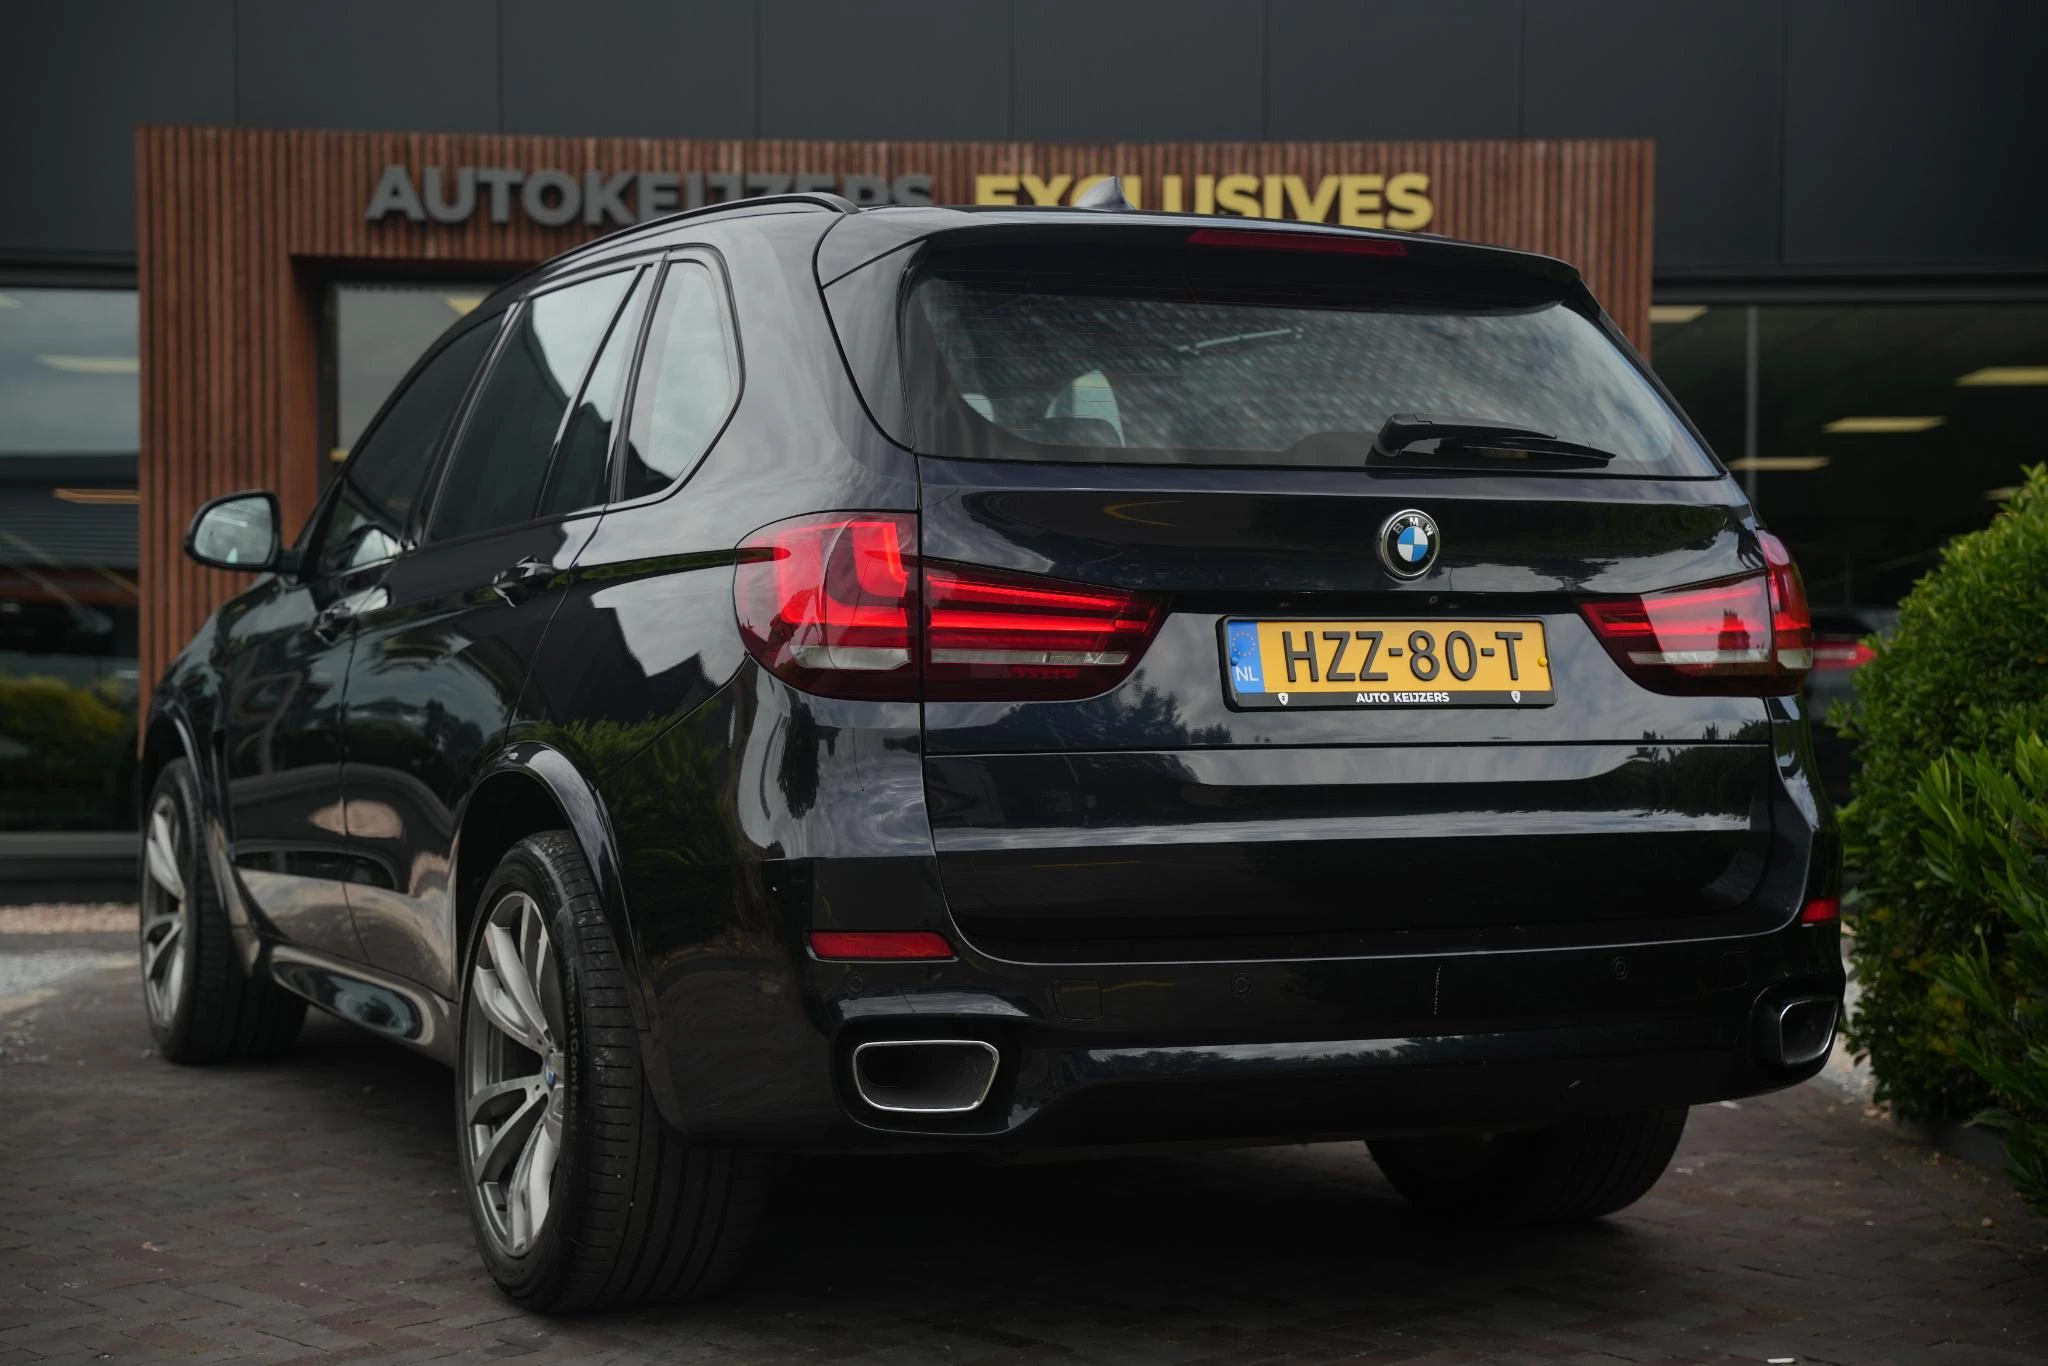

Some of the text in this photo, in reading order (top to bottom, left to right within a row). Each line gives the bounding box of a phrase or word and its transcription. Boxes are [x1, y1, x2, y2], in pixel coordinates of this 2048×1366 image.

[1393, 517, 1434, 536] BMW
[1282, 630, 1523, 682] HZZ-80-T
[1235, 666, 1259, 682] NL
[1356, 692, 1450, 703] AUTO KEIJZERS
